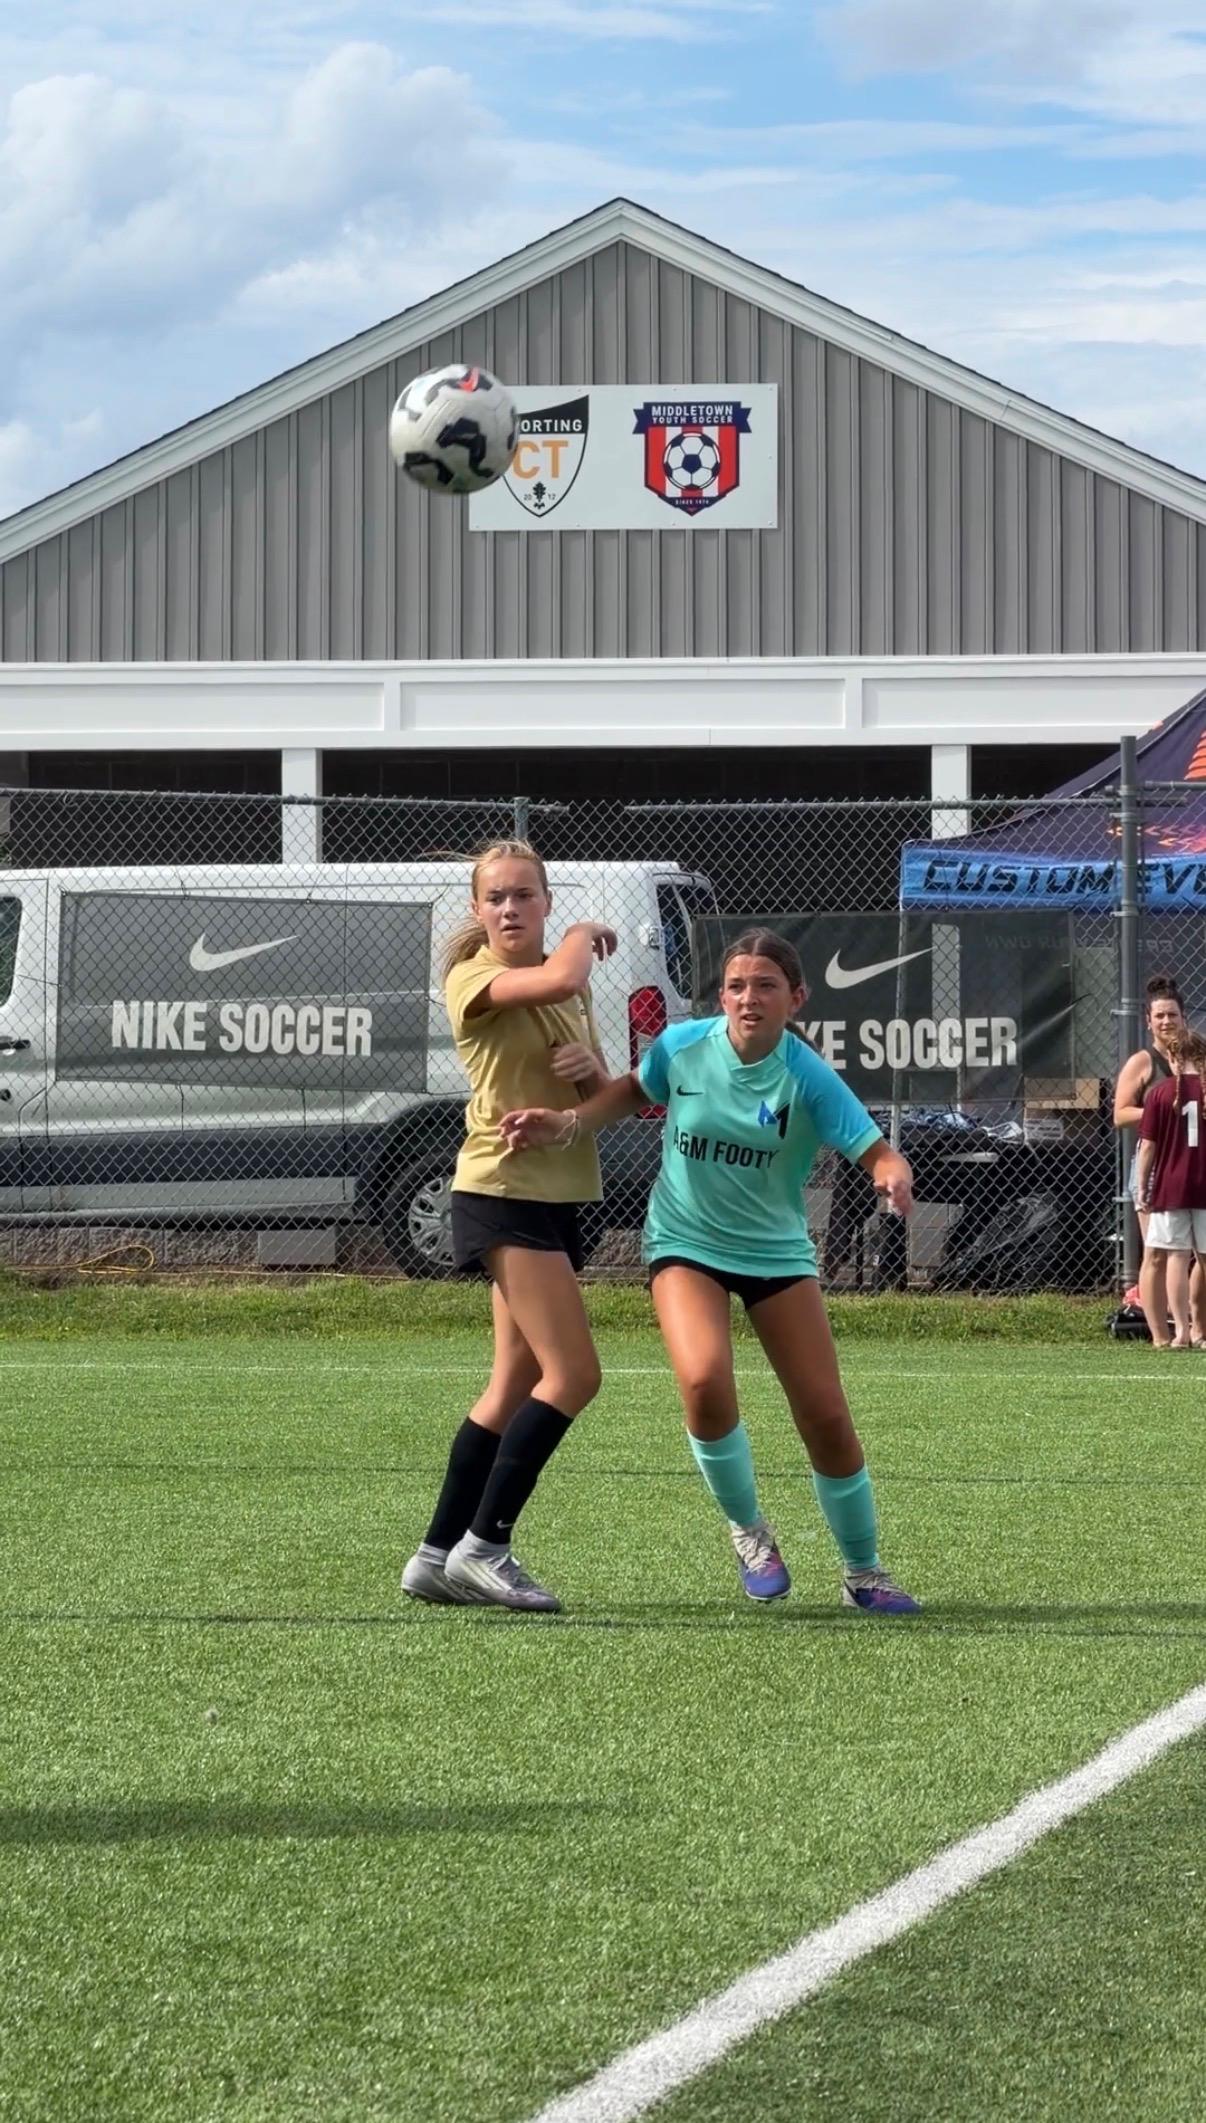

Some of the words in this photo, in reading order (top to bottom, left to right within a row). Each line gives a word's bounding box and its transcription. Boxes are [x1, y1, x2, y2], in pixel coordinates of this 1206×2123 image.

[520, 418, 583, 433] ORTING
[651, 405, 733, 417] MIDDLETOWN
[652, 416, 687, 425] YOUTH
[692, 416, 733, 425] SOCCER
[512, 440, 569, 480] CT
[923, 860, 1116, 894] CUSTOM
[112, 1000, 207, 1052] NIKE
[219, 1003, 372, 1057] SOCCER
[859, 1017, 1018, 1071] SOCCER
[1182, 1100, 1198, 1148] 1
[674, 1125, 709, 1162] A&M
[713, 1140, 780, 1169] FOOTY
